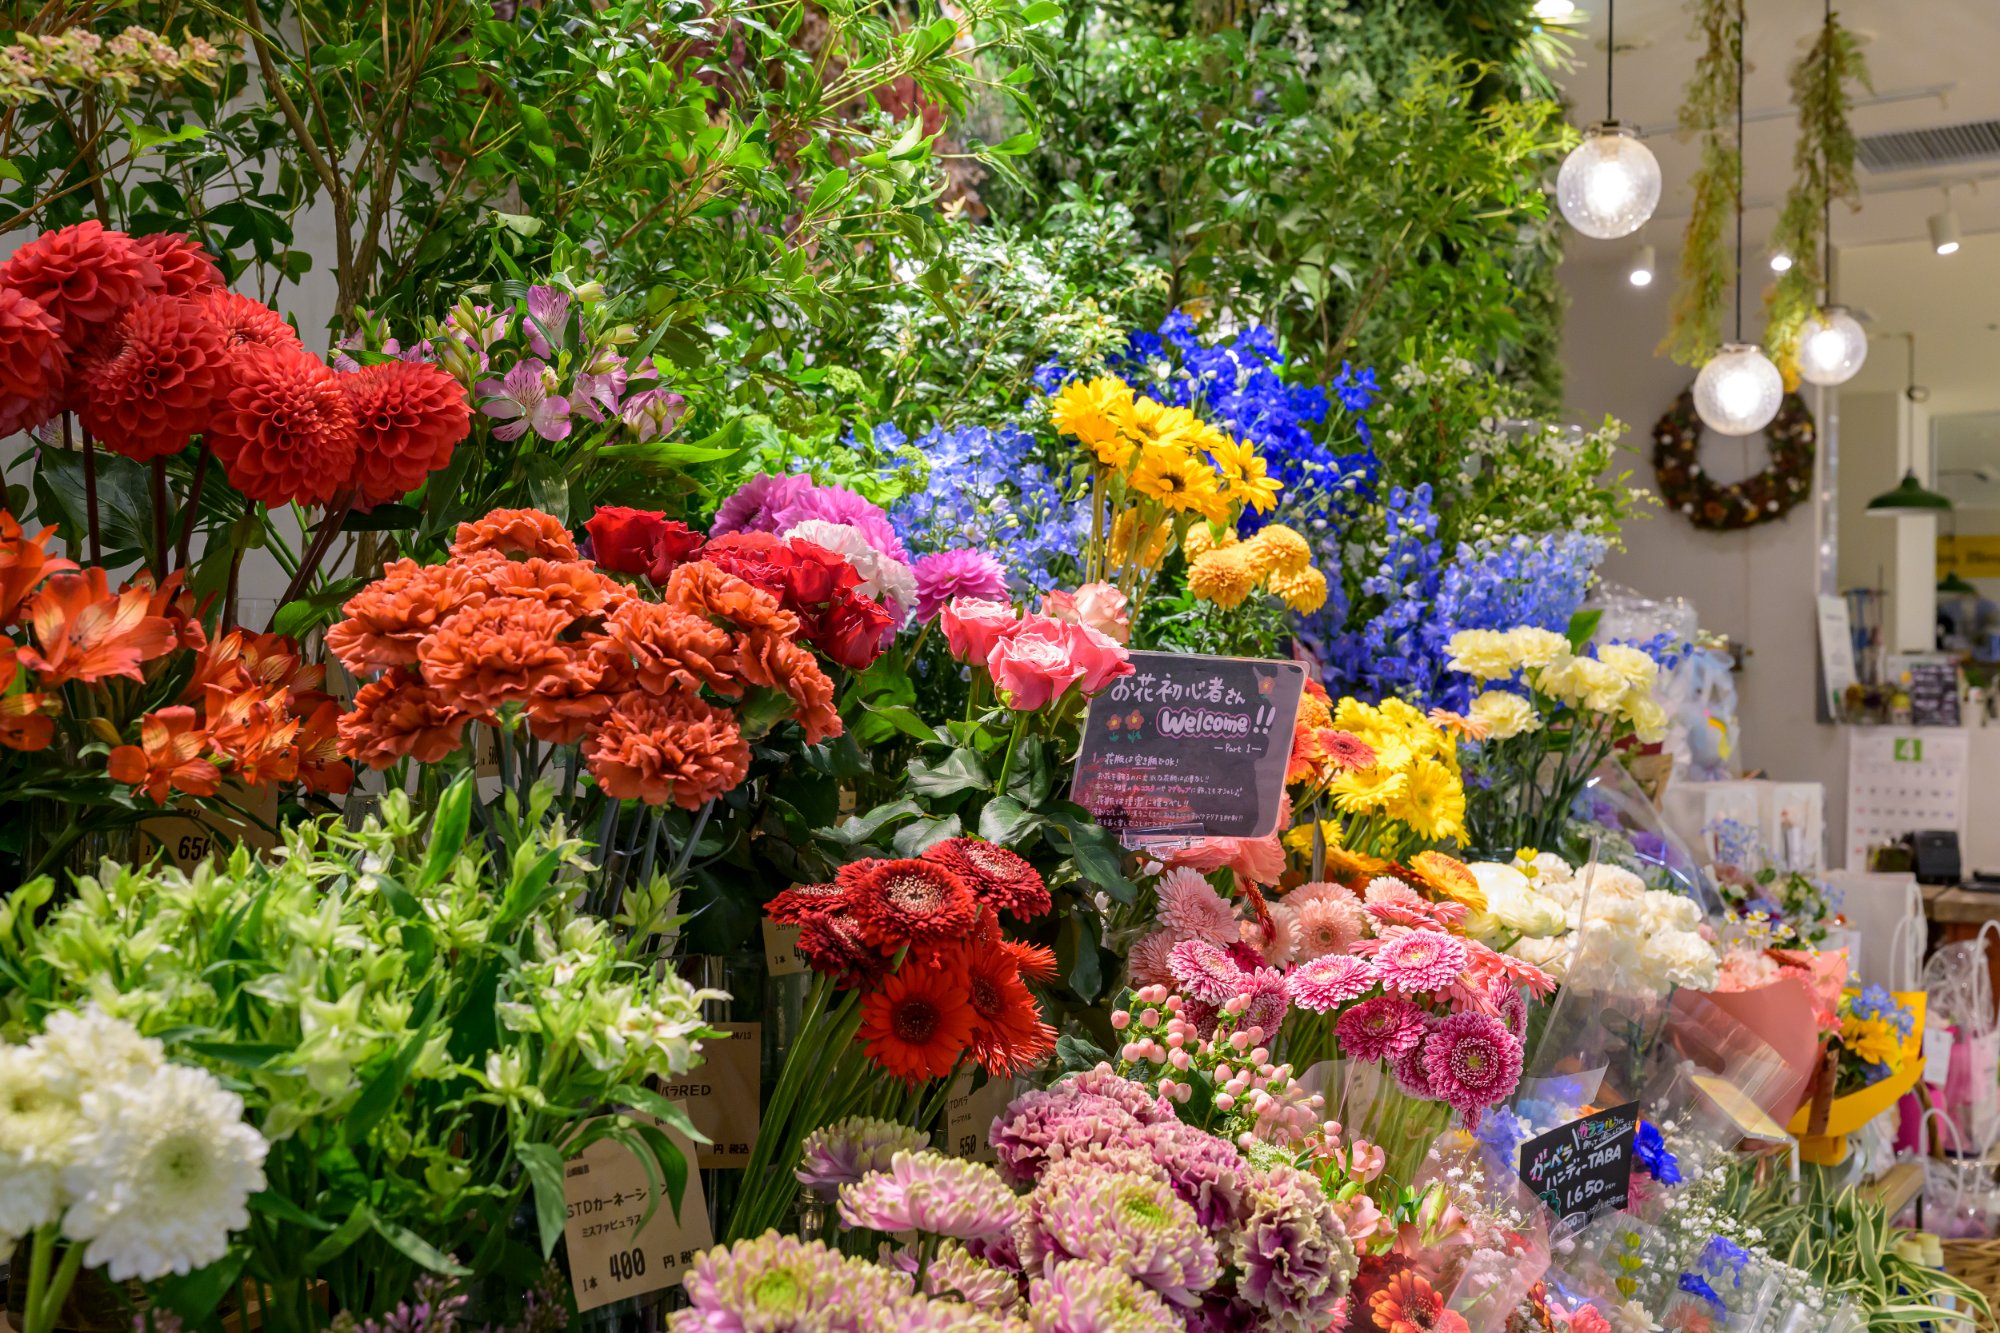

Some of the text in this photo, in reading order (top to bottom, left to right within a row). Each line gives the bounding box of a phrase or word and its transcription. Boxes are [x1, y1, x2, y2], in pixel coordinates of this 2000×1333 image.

[1111, 673, 1246, 705] お花初心者さん
[1529, 1143, 1574, 1181] ガーベラ
[567, 1183, 669, 1219] STDカーネーシン
[583, 1247, 701, 1292] 1本 400 円 税
